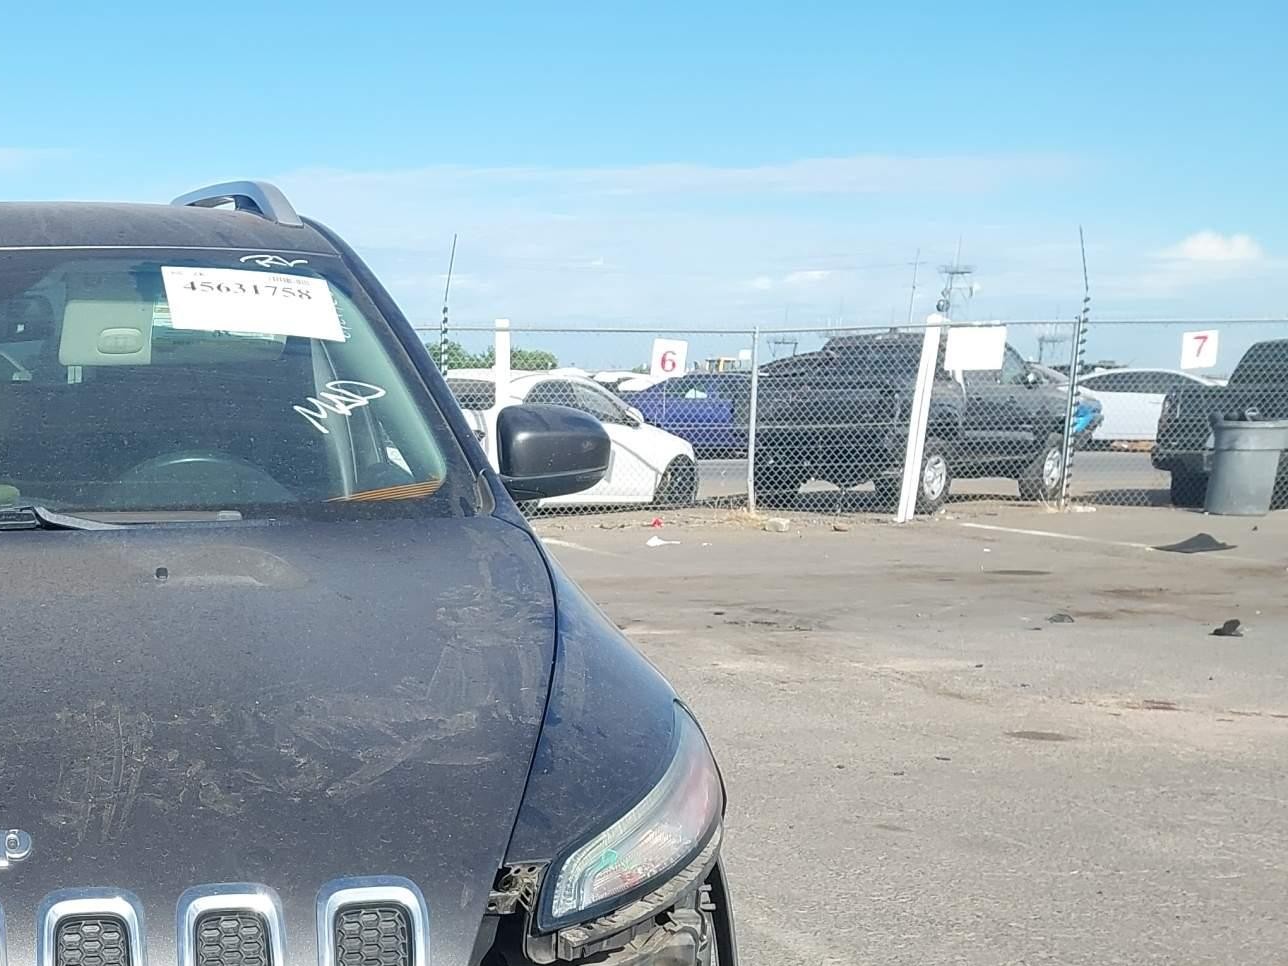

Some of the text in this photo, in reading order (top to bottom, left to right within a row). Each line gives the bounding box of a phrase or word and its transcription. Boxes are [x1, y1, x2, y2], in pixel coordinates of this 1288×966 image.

[183, 280, 313, 300] 45631758
[1192, 335, 1209, 358] 7
[660, 350, 677, 373] 6
